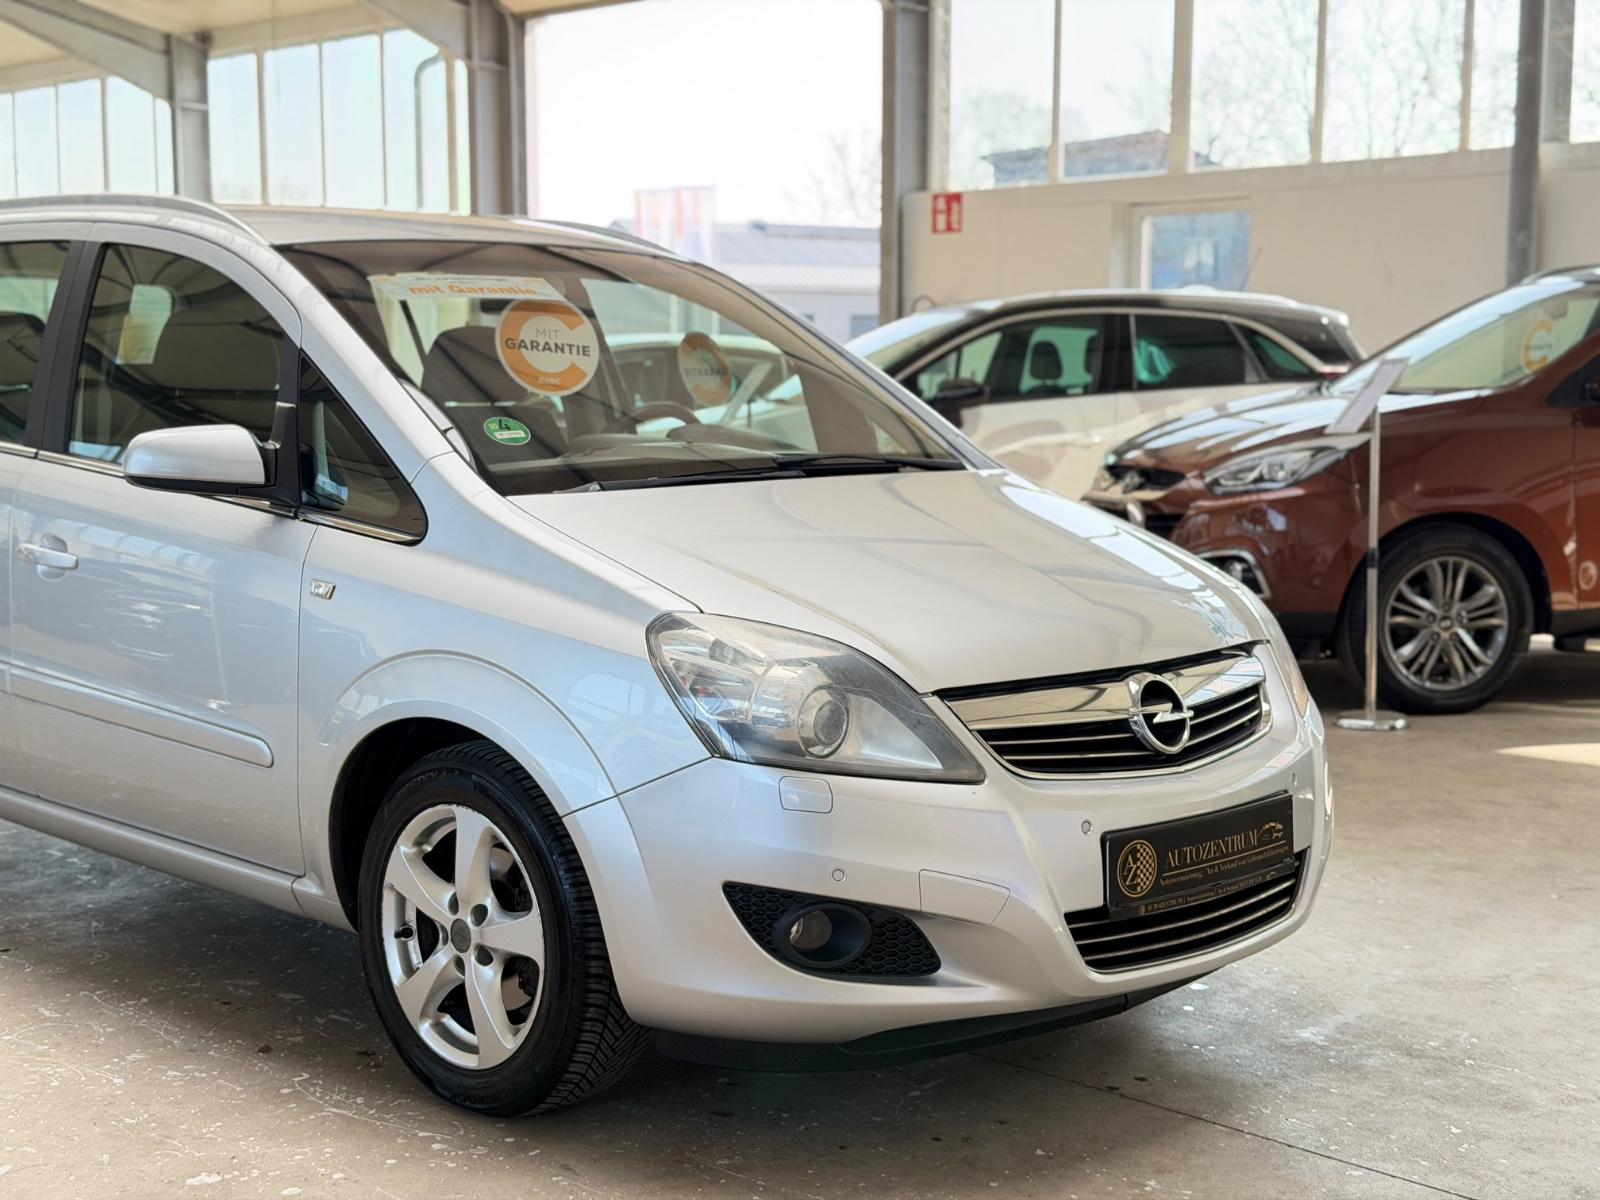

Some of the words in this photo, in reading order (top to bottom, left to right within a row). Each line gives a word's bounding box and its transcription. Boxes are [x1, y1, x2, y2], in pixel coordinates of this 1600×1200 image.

[408, 284, 445, 295] mit
[448, 284, 537, 295] Garantie
[535, 328, 561, 339] MIT
[504, 337, 592, 358] GARANTIE
[1165, 829, 1258, 869] AUTOZENTRUM
